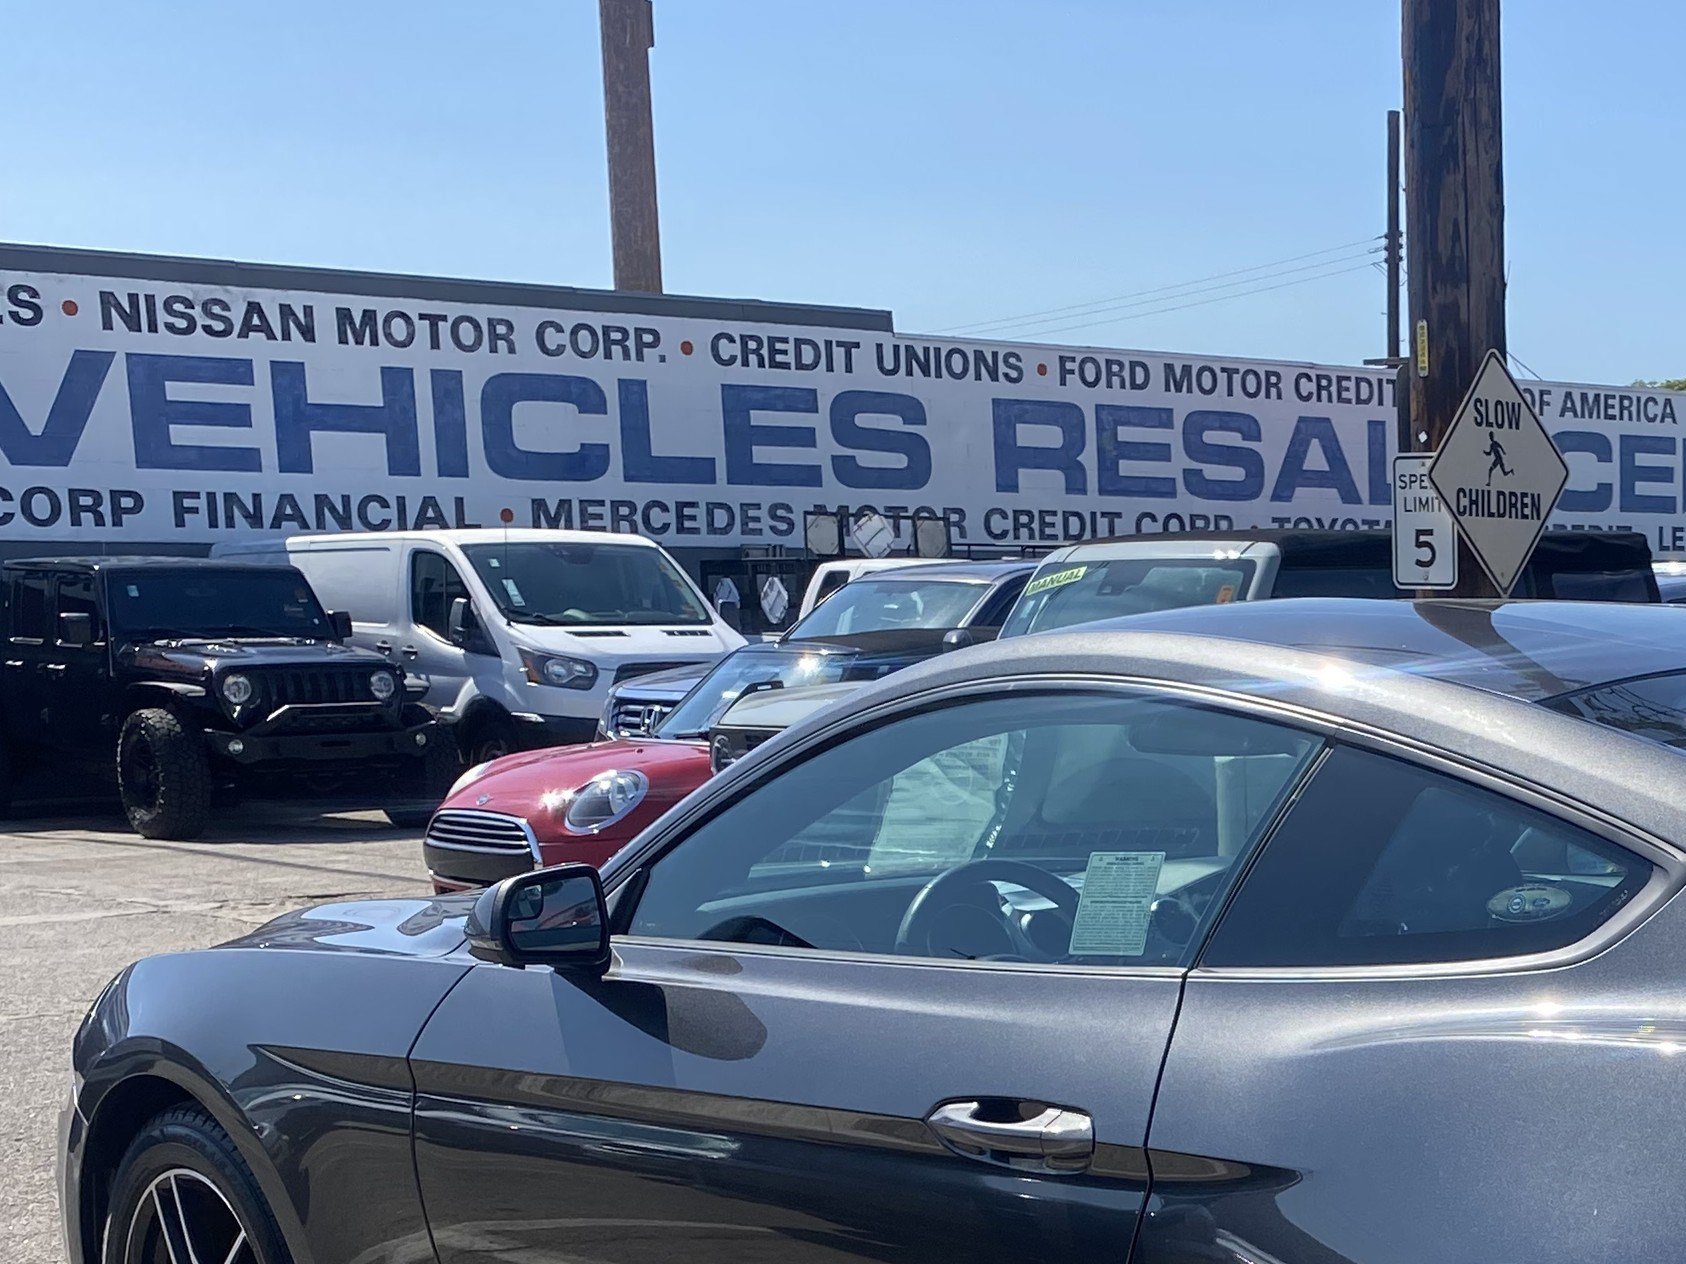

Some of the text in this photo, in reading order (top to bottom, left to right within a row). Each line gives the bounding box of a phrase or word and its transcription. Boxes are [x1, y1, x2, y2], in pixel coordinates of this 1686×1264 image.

[0, 284, 1398, 408] S NISSAN MOTOR CORP. CREDIT UNIONS FORD MOTOR CREDIT
[1472, 397, 1522, 430] SLOW
[1558, 390, 1678, 425] AMERICA
[0, 349, 933, 491] VEHICLES
[991, 397, 1392, 505] RESAL
[1399, 473, 1433, 490] SPE
[172, 490, 483, 530] FINANCIAL
[531, 498, 795, 536] MERCEDES
[983, 507, 1123, 541] CREDIT
[1404, 496, 1442, 513] LIMIT
[1456, 487, 1541, 520] CHILDREN
[1415, 528, 1437, 568] 5
[1027, 568, 1081, 595] MANUAL
